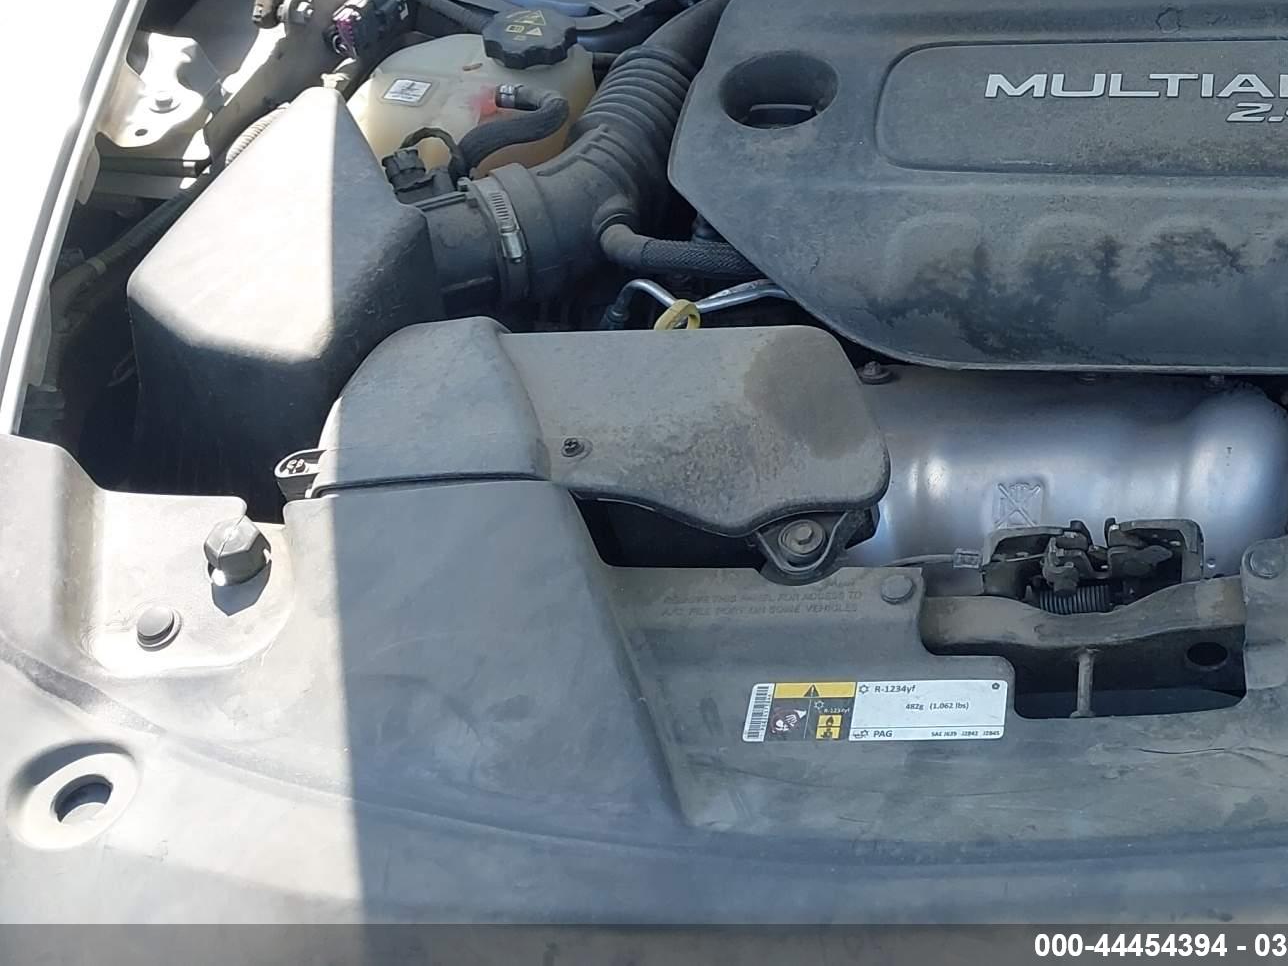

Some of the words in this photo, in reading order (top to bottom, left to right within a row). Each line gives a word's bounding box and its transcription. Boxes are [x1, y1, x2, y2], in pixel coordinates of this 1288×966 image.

[777, 592, 800, 601] FOR
[847, 590, 863, 600] TO
[805, 603, 859, 614] VEHICLES
[874, 684, 916, 695] R-1234yf
[905, 702, 925, 712] 482g
[955, 701, 970, 711] lbs)
[873, 729, 893, 739] PAG
